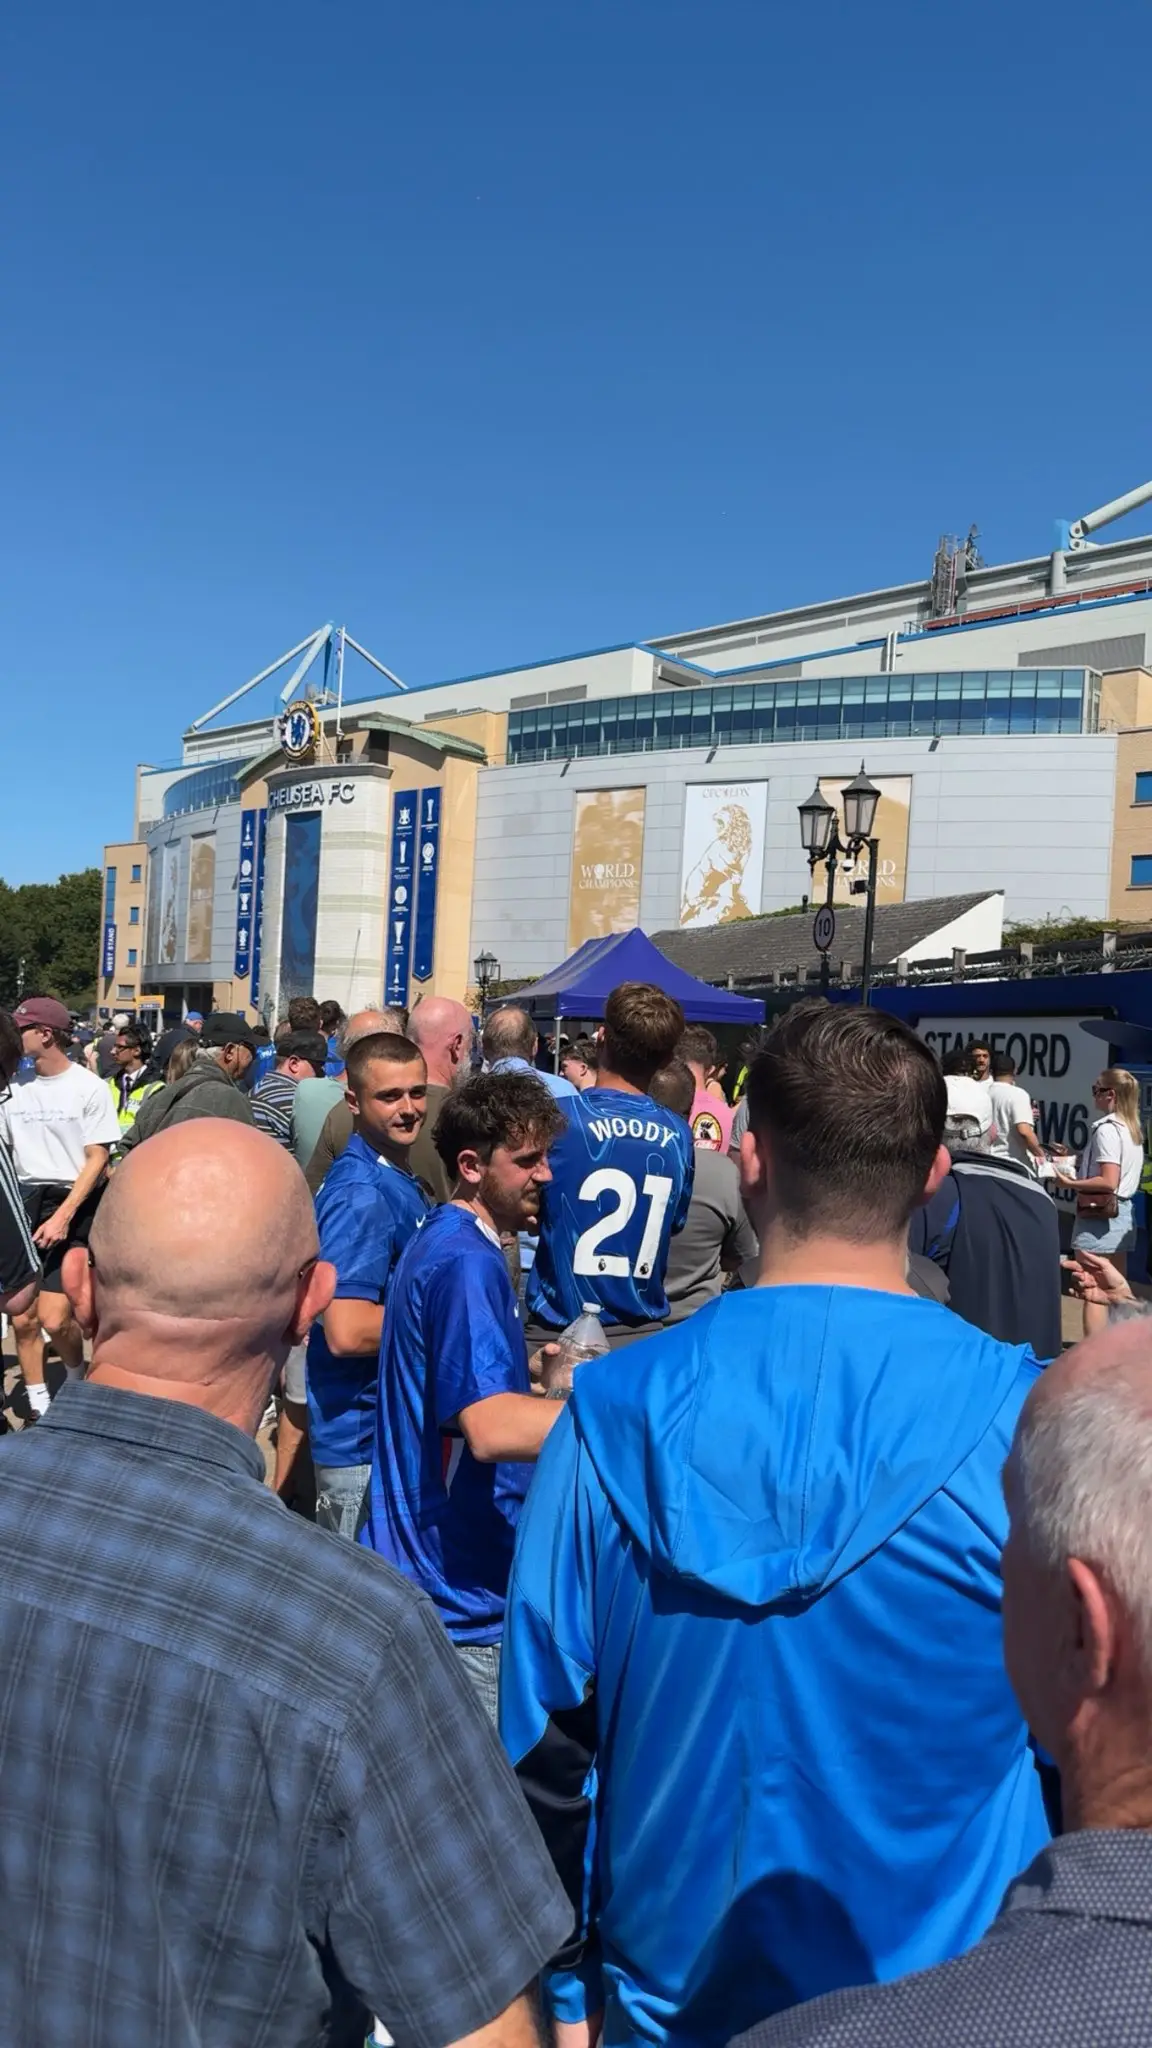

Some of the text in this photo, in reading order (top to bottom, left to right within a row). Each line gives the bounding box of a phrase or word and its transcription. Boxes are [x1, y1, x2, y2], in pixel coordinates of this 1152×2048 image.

[268, 782, 354, 808] CHELSEA FC
[580, 863, 635, 879] WORLD
[818, 917, 831, 937] 10
[106, 928, 115, 972] WEST STAND
[588, 1117, 677, 1149] WOODY
[1033, 1099, 1089, 1151] W6
[573, 1168, 673, 1280] 21
